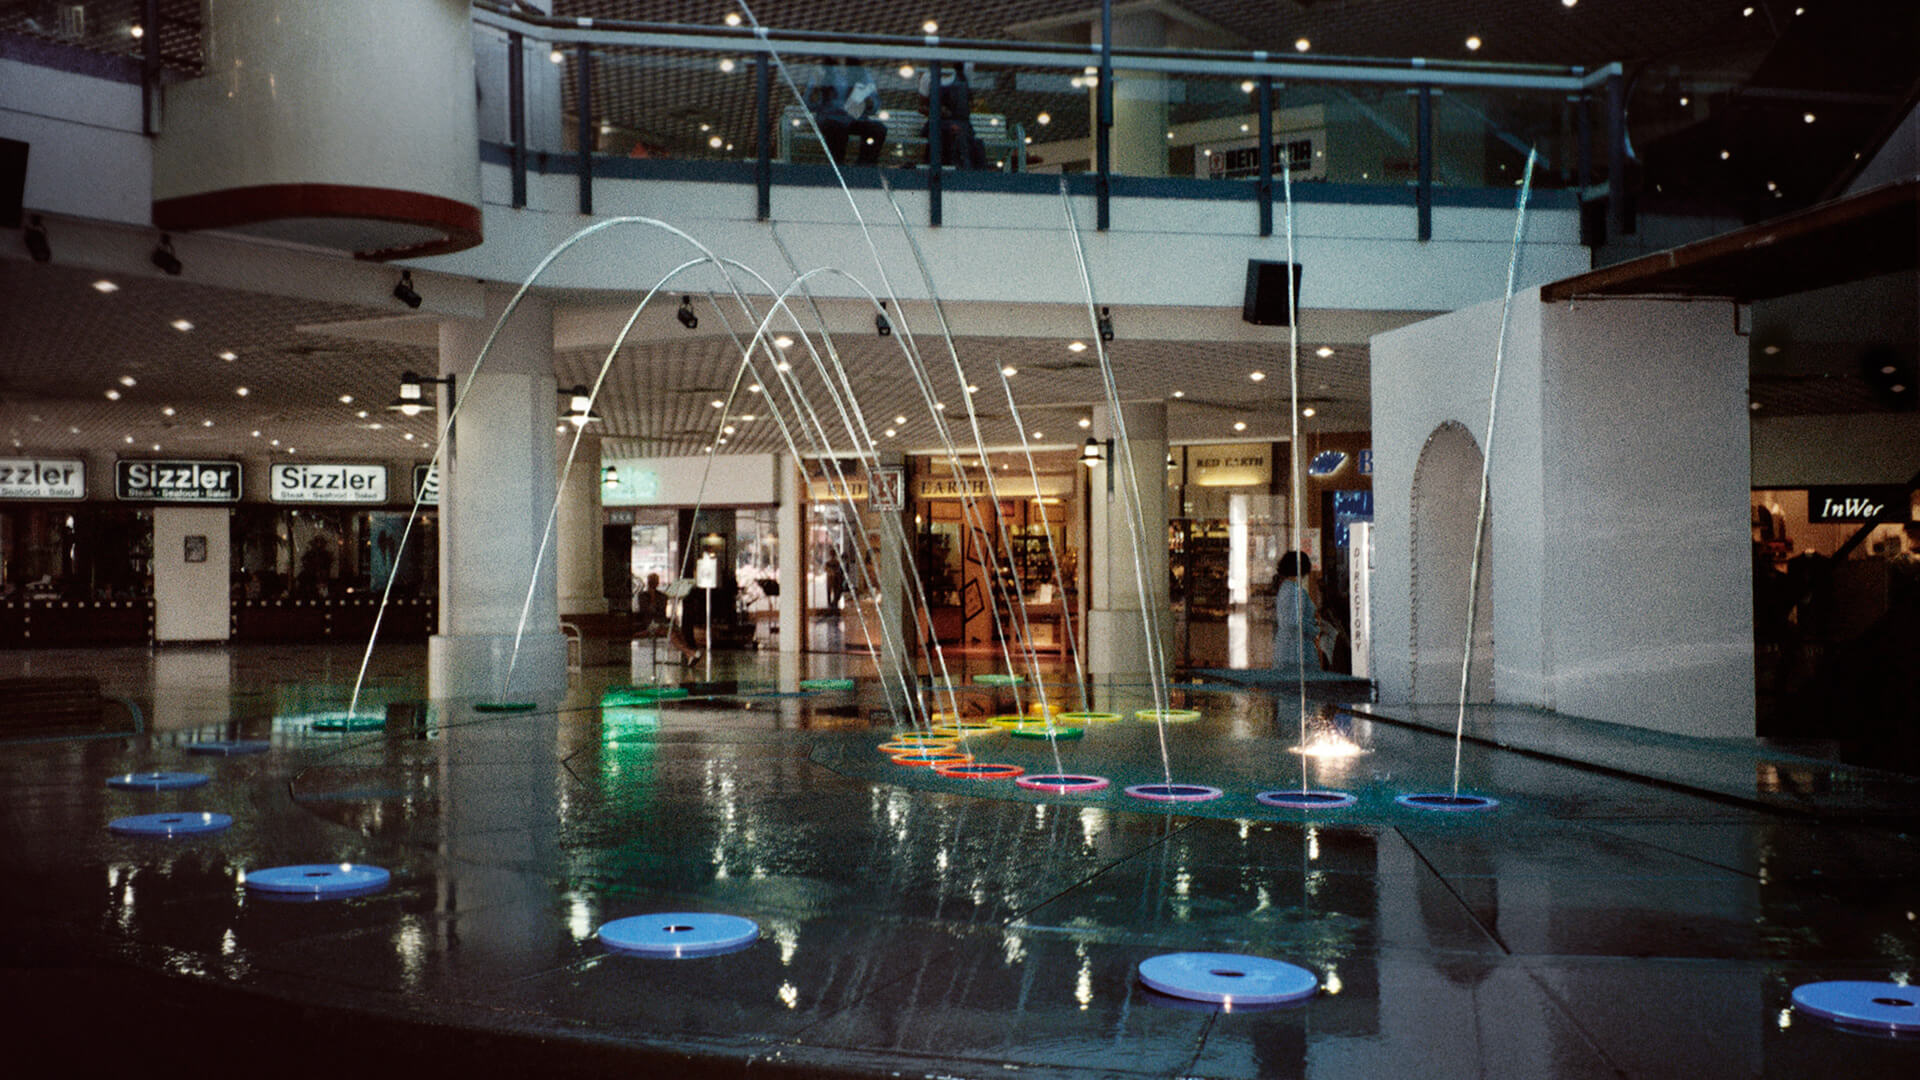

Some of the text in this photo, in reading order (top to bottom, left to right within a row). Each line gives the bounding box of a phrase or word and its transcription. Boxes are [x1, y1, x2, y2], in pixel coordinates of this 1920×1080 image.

[128, 464, 231, 489] Sizzler
[281, 466, 377, 489] Sizzler
[921, 480, 984, 495] EARTH
